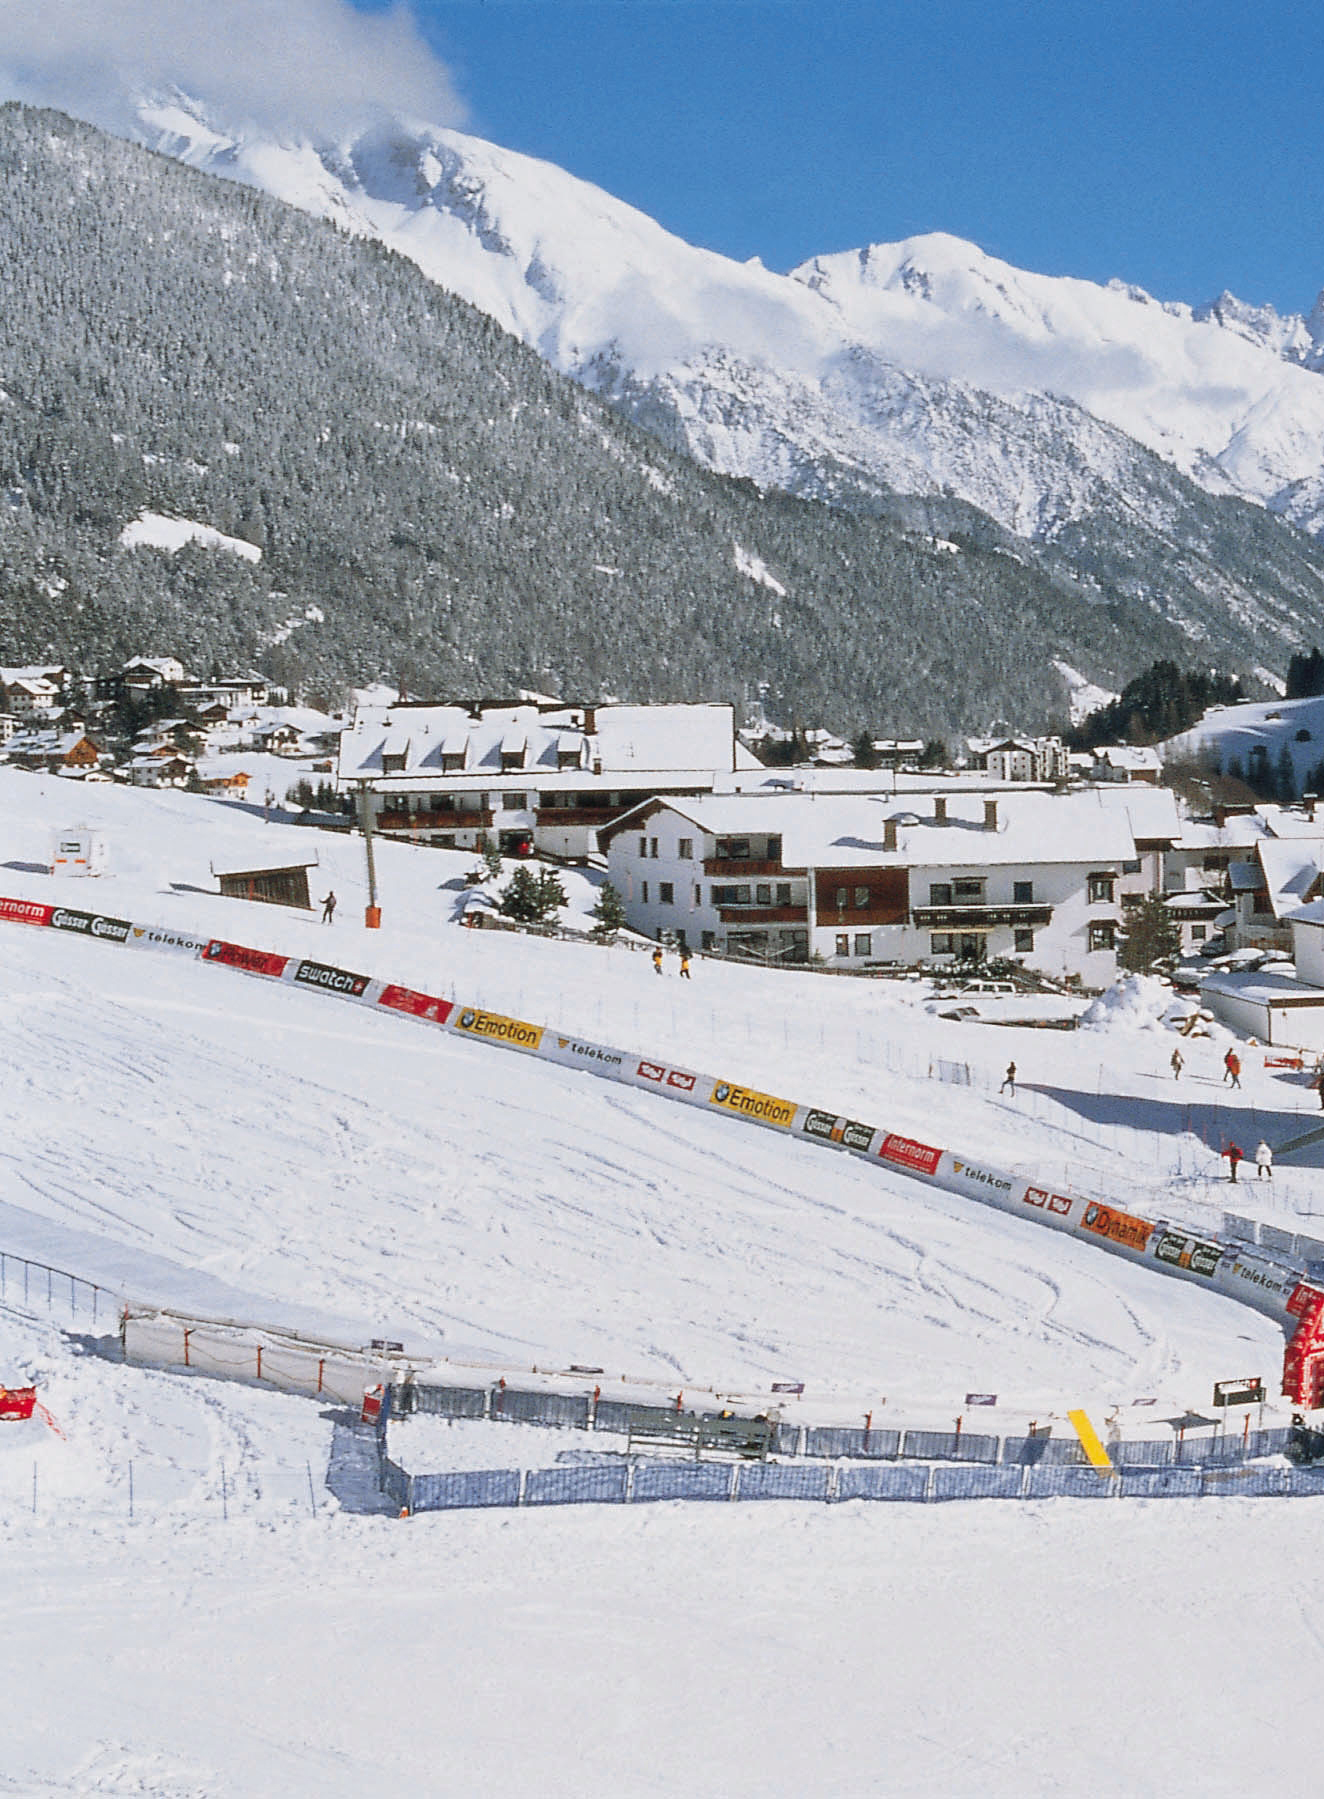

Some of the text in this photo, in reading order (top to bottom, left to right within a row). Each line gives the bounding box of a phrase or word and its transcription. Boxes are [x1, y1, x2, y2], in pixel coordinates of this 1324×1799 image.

[299, 965, 354, 991] swatch
[474, 1015, 537, 1044] Emotion
[571, 1043, 622, 1065] telekom
[729, 1089, 790, 1122] Emotion
[887, 1136, 935, 1162] Internorm
[965, 1167, 1012, 1191] telekom
[1241, 1266, 1283, 1292] telekom
